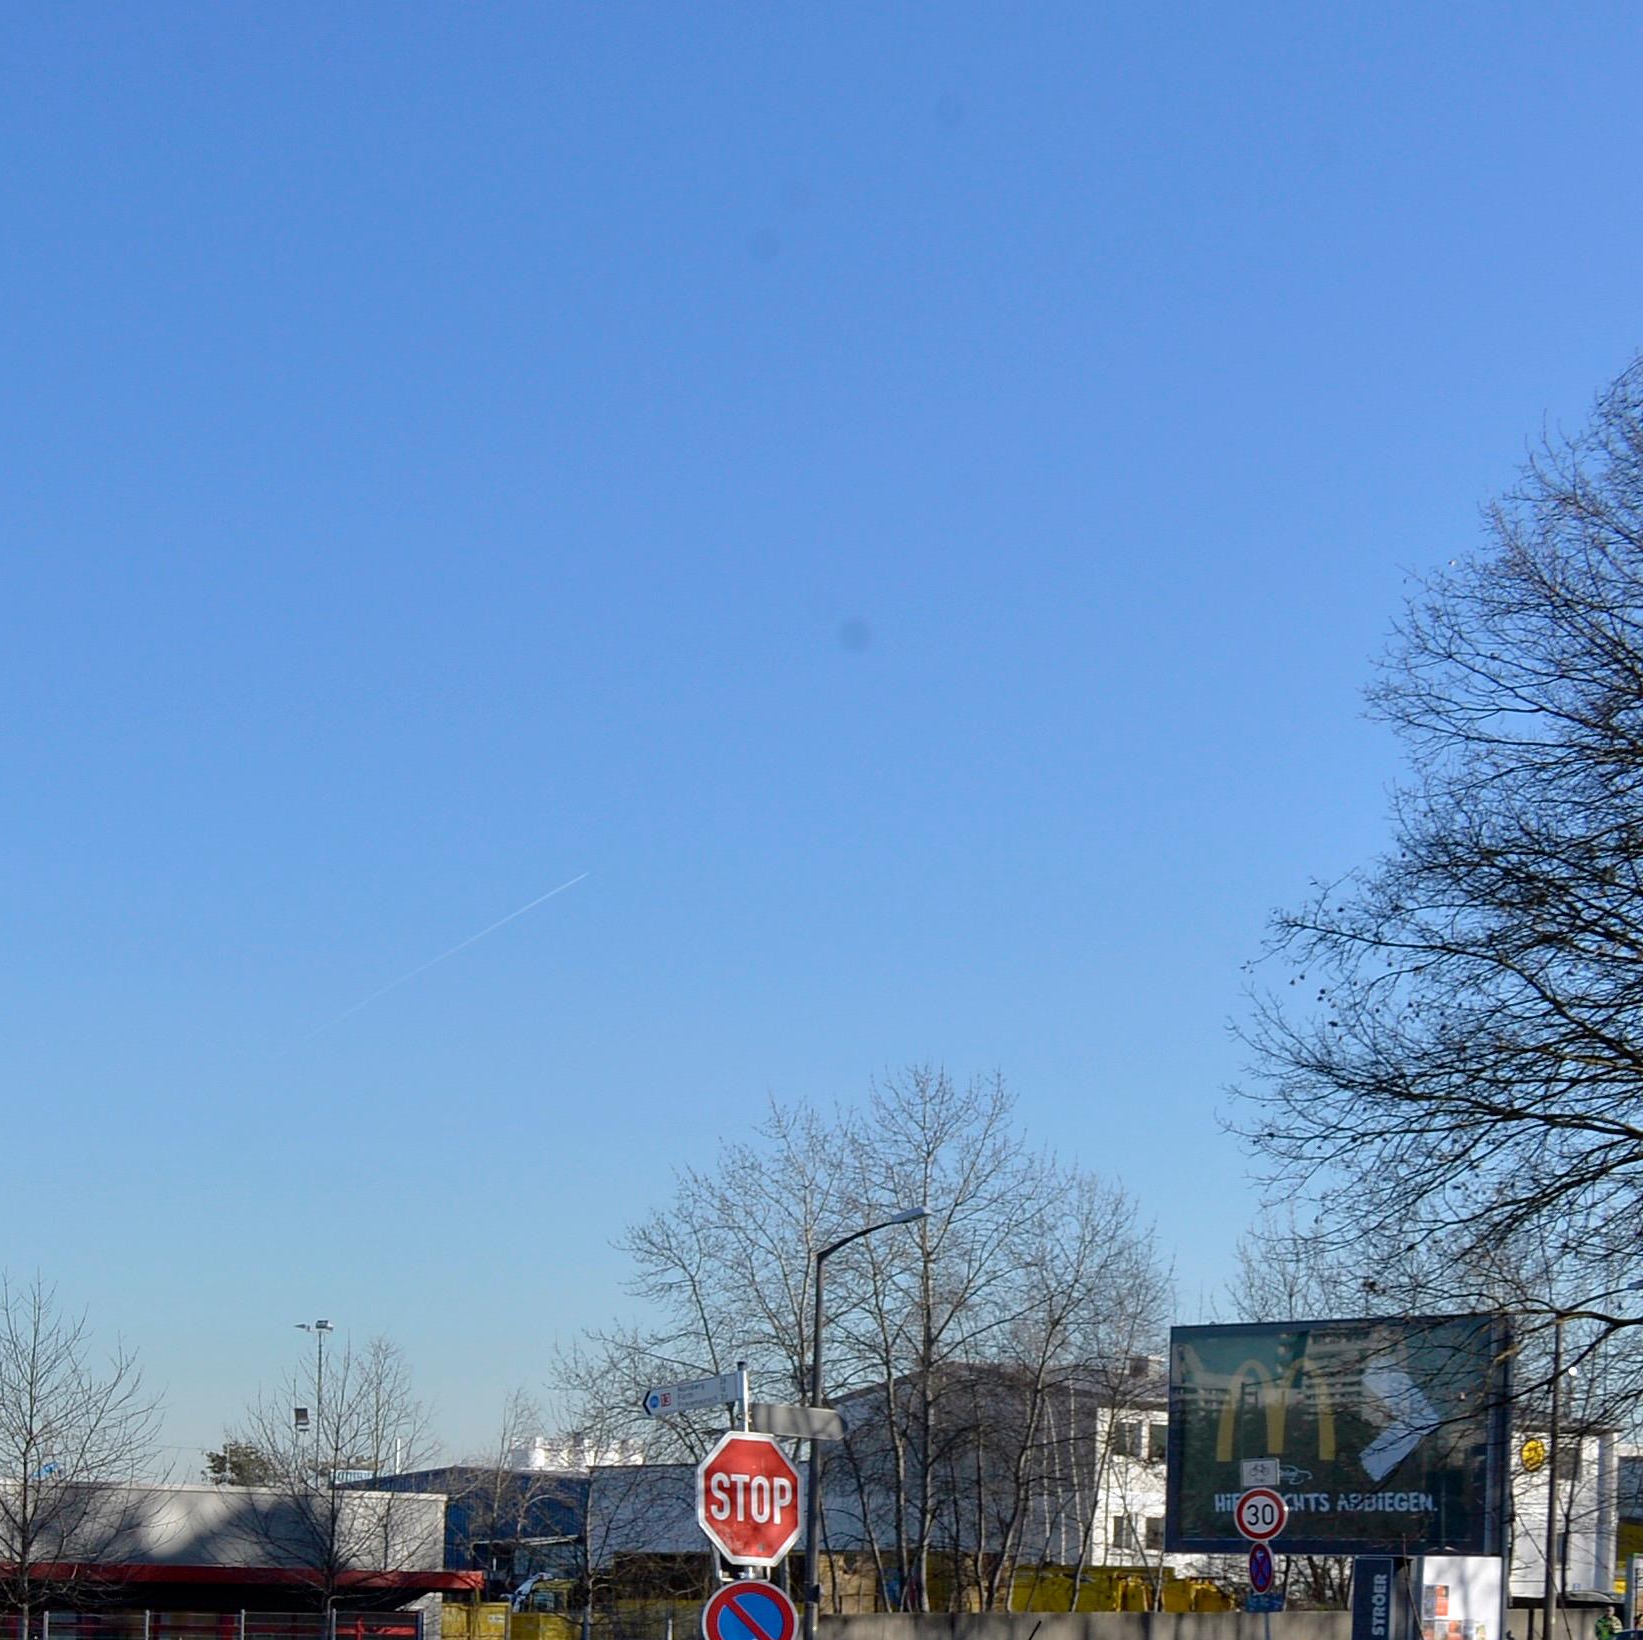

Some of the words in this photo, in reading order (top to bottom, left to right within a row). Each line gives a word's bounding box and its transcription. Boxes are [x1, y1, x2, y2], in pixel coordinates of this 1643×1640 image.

[710, 1472, 792, 1525] STOP
[1246, 1503, 1275, 1527] 30
[1371, 1573, 1388, 1637] STRÖER
